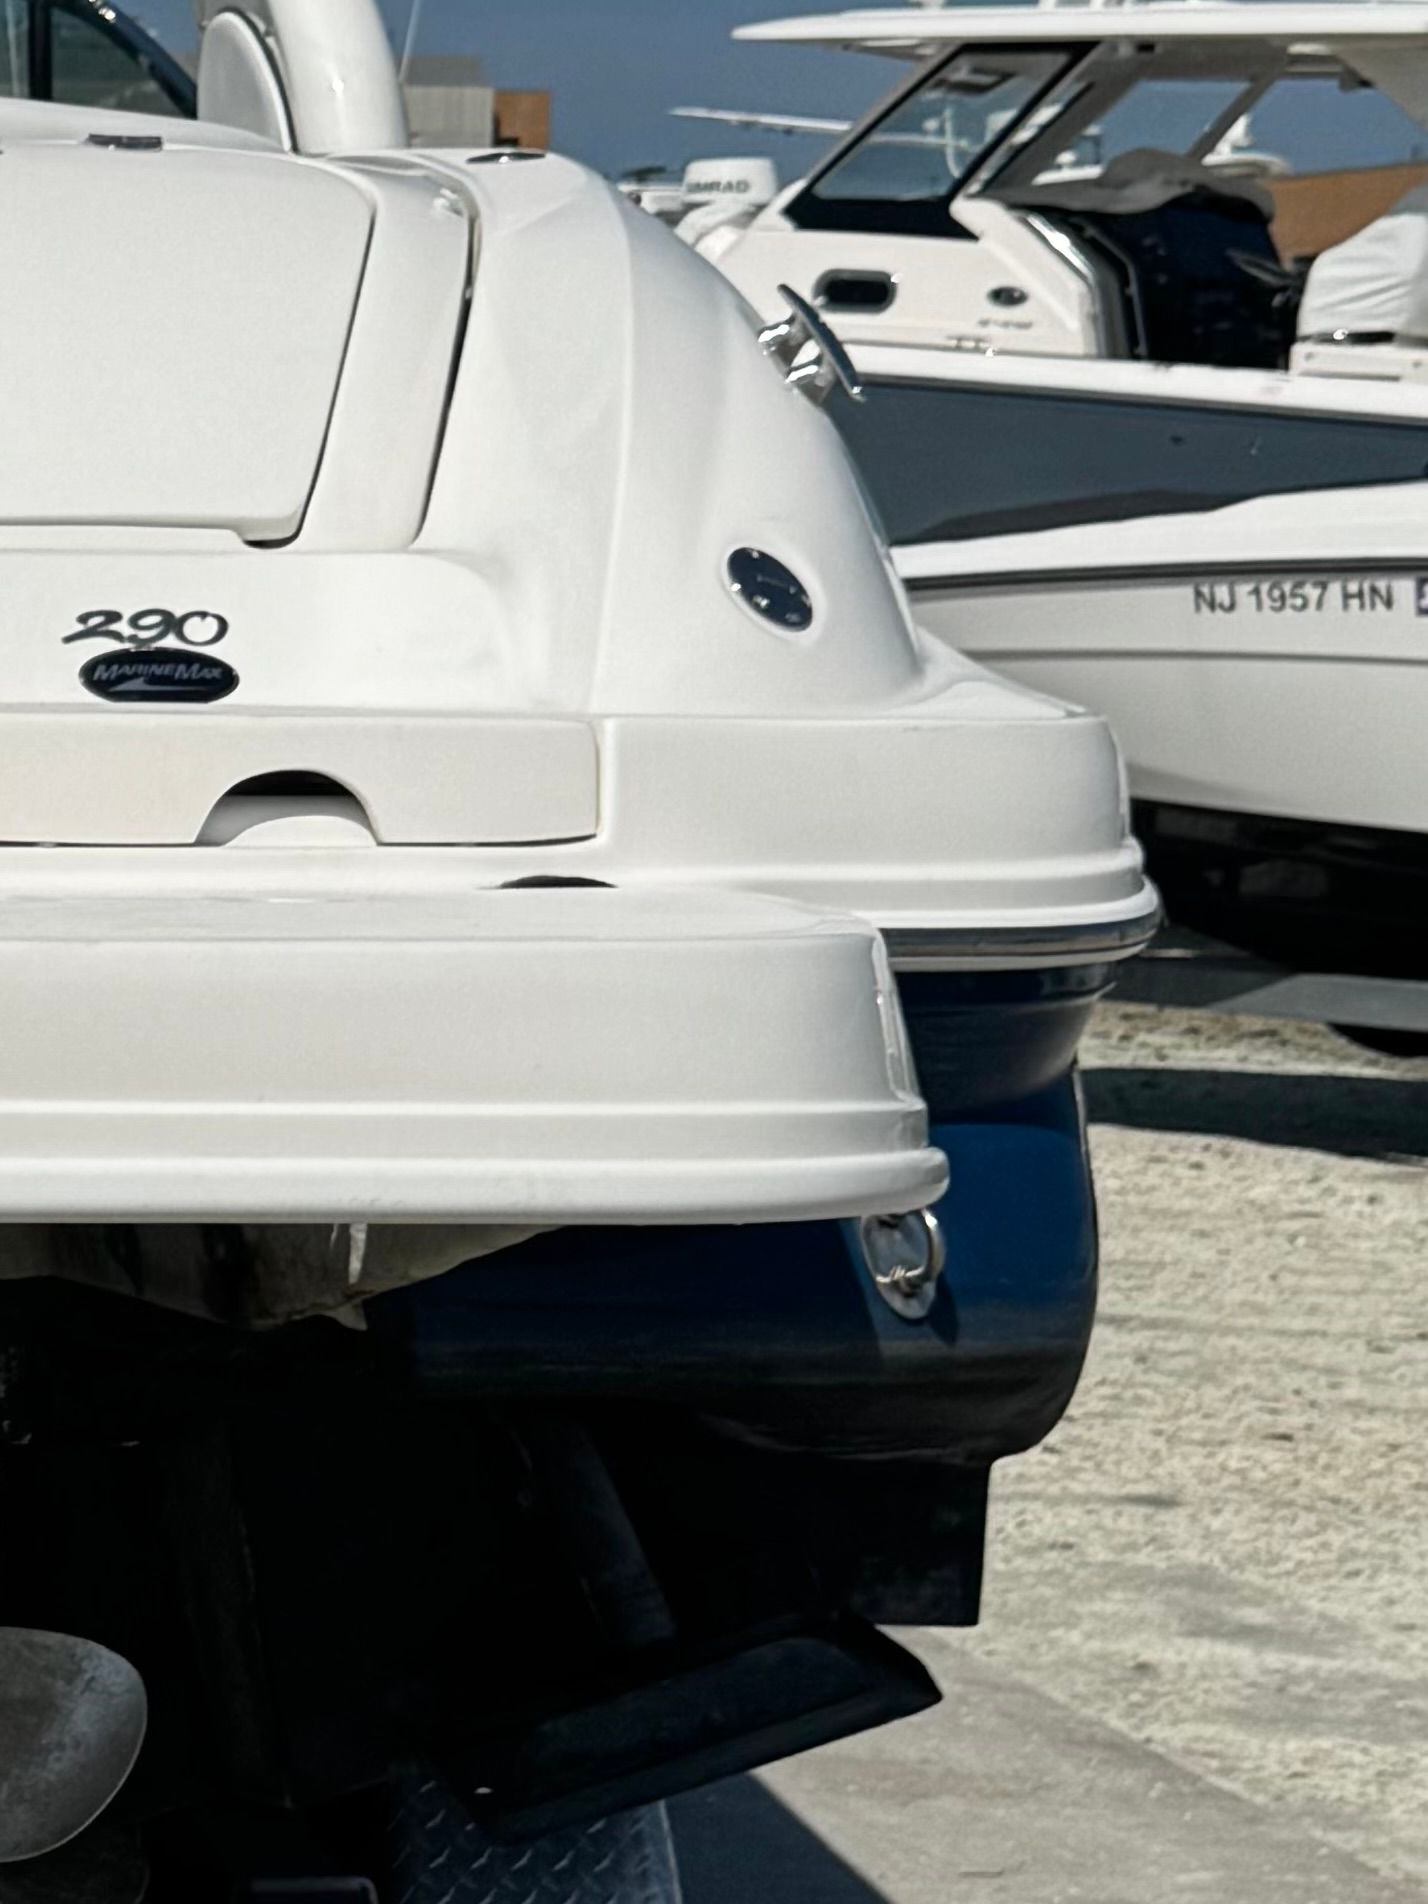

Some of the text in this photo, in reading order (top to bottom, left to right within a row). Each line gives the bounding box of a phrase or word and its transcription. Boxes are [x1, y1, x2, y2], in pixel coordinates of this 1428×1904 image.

[1194, 581, 1236, 613] NJ
[1247, 580, 1329, 612] 1957
[1341, 578, 1394, 611] HN
[61, 608, 229, 648] 290
